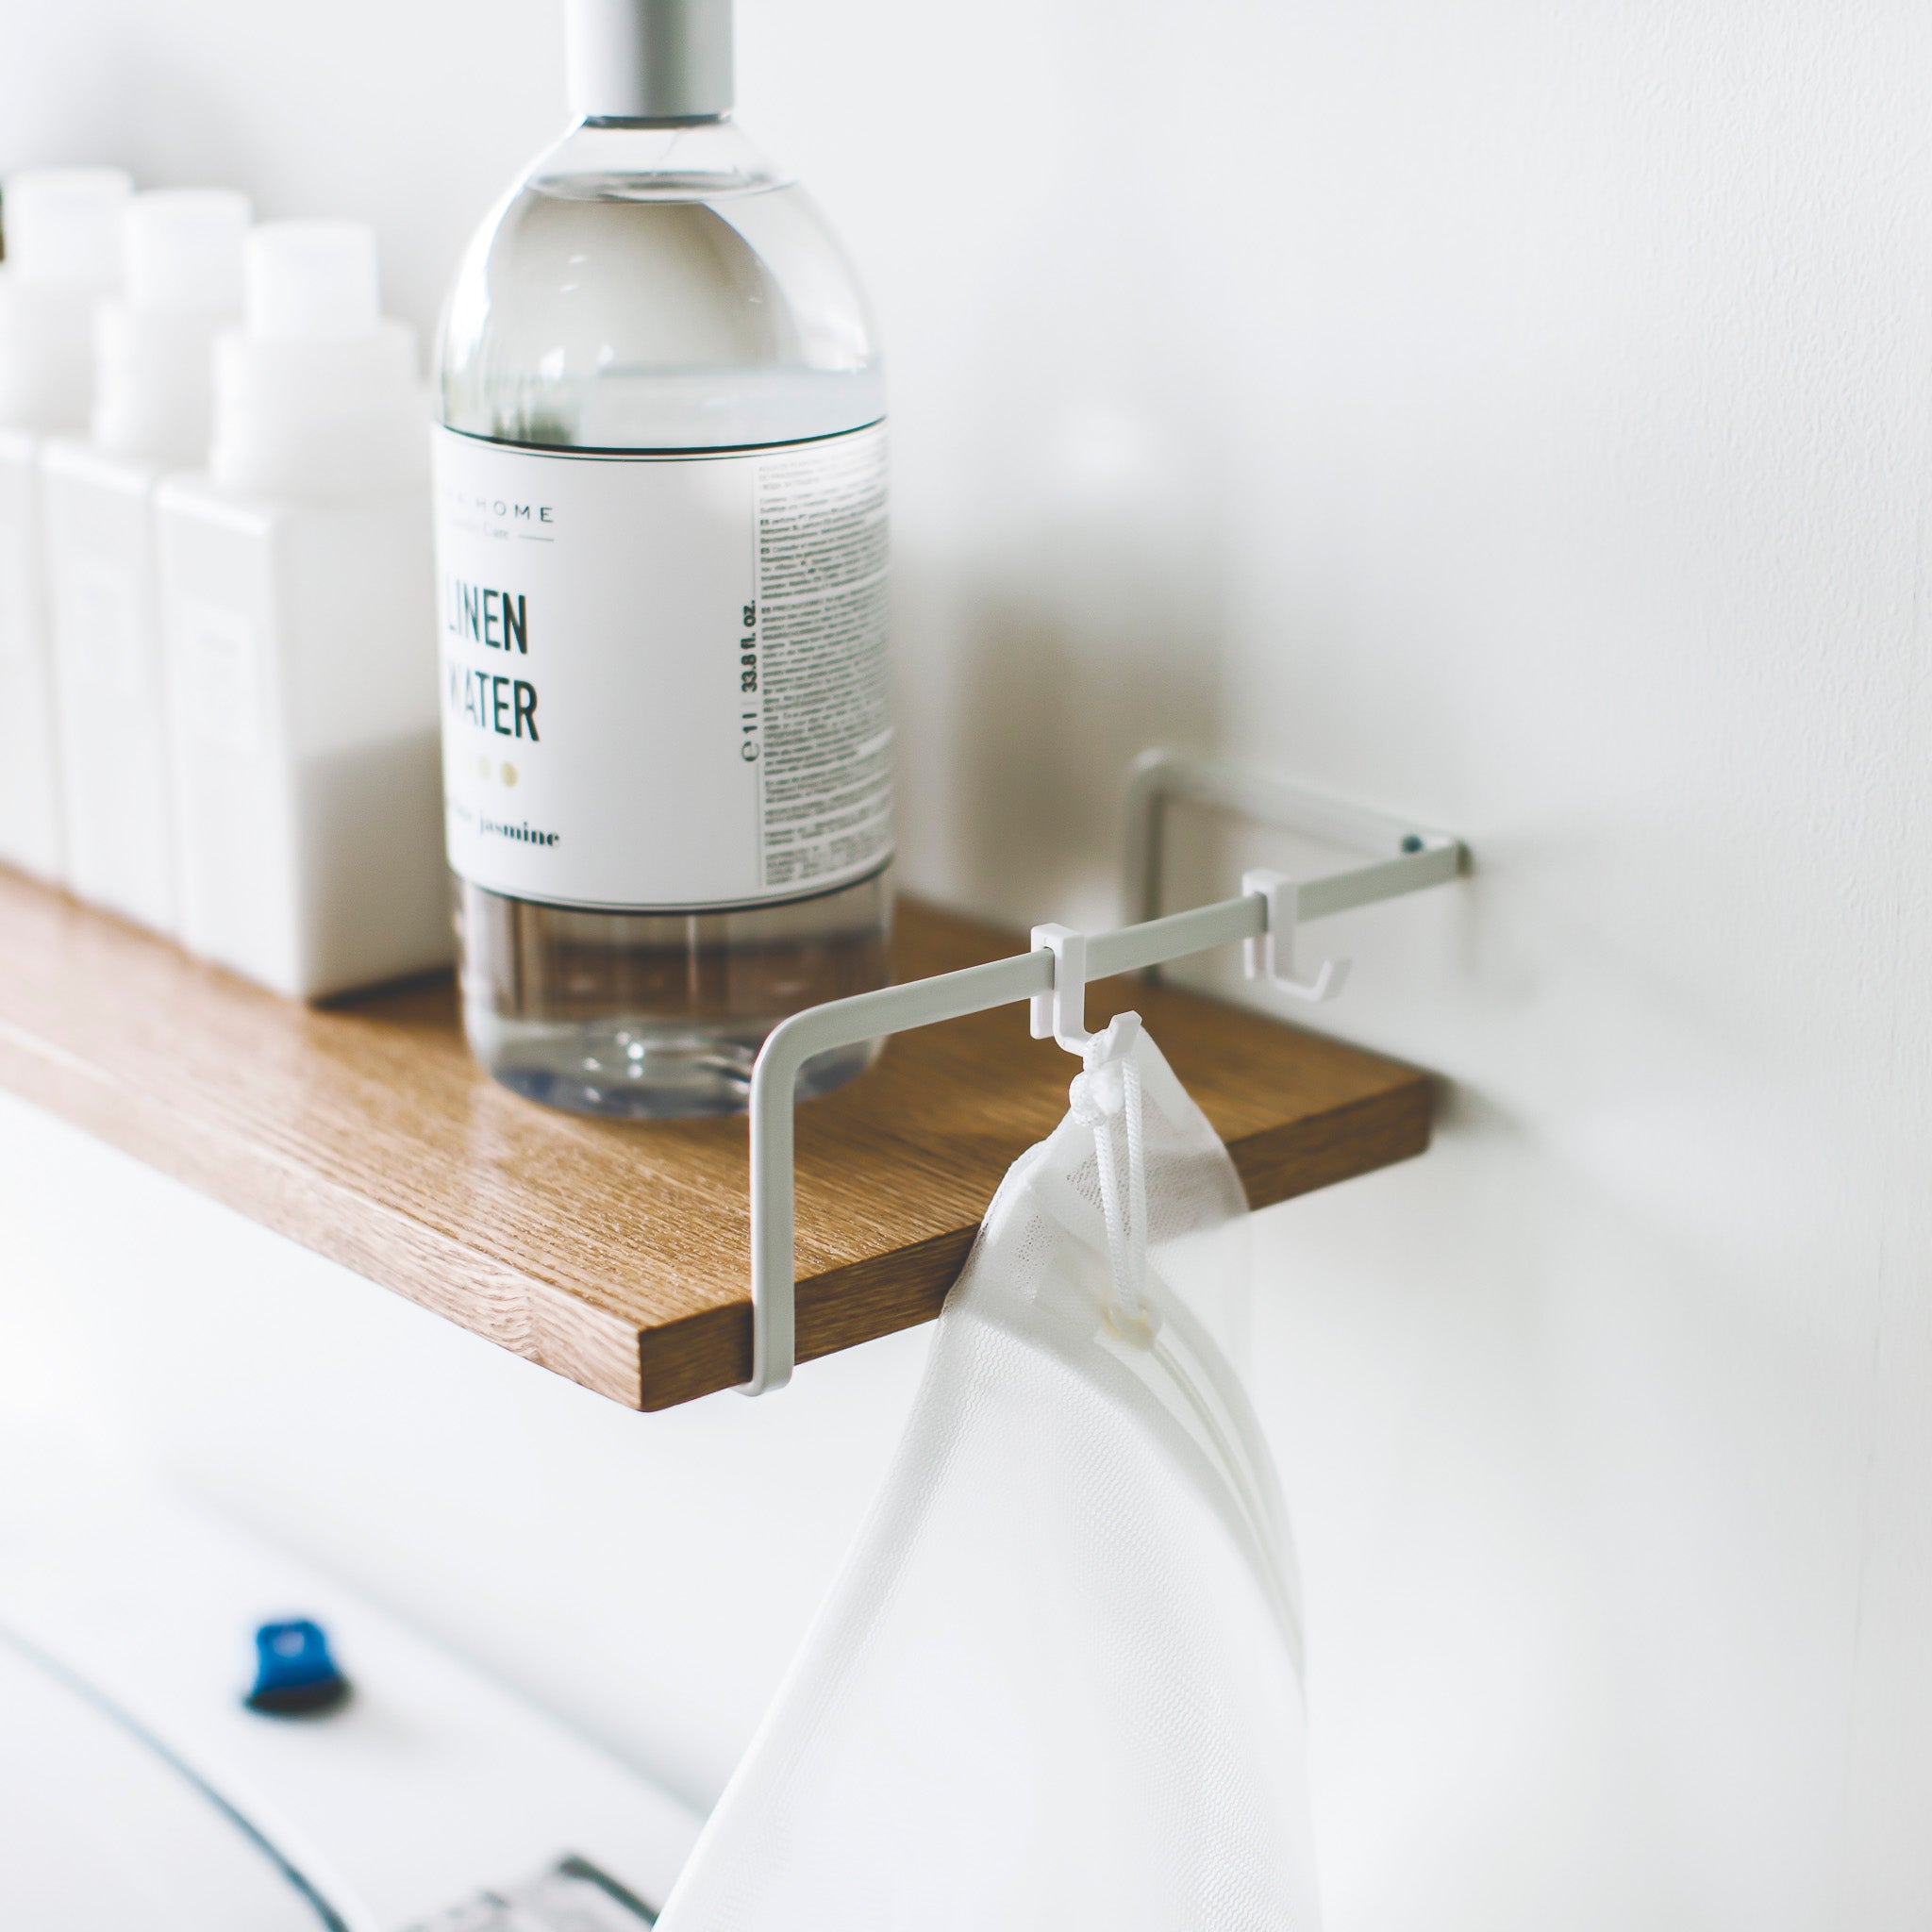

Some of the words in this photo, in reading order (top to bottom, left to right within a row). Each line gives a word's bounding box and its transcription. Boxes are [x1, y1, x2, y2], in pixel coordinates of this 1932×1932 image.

[475, 497, 556, 525] HOME
[445, 575, 528, 656] LINEN
[743, 599, 756, 627] oz.
[741, 632, 756, 648] fl.
[741, 654, 758, 692] 33.8
[448, 662, 541, 743] WATER
[480, 808, 562, 849] jasmine
